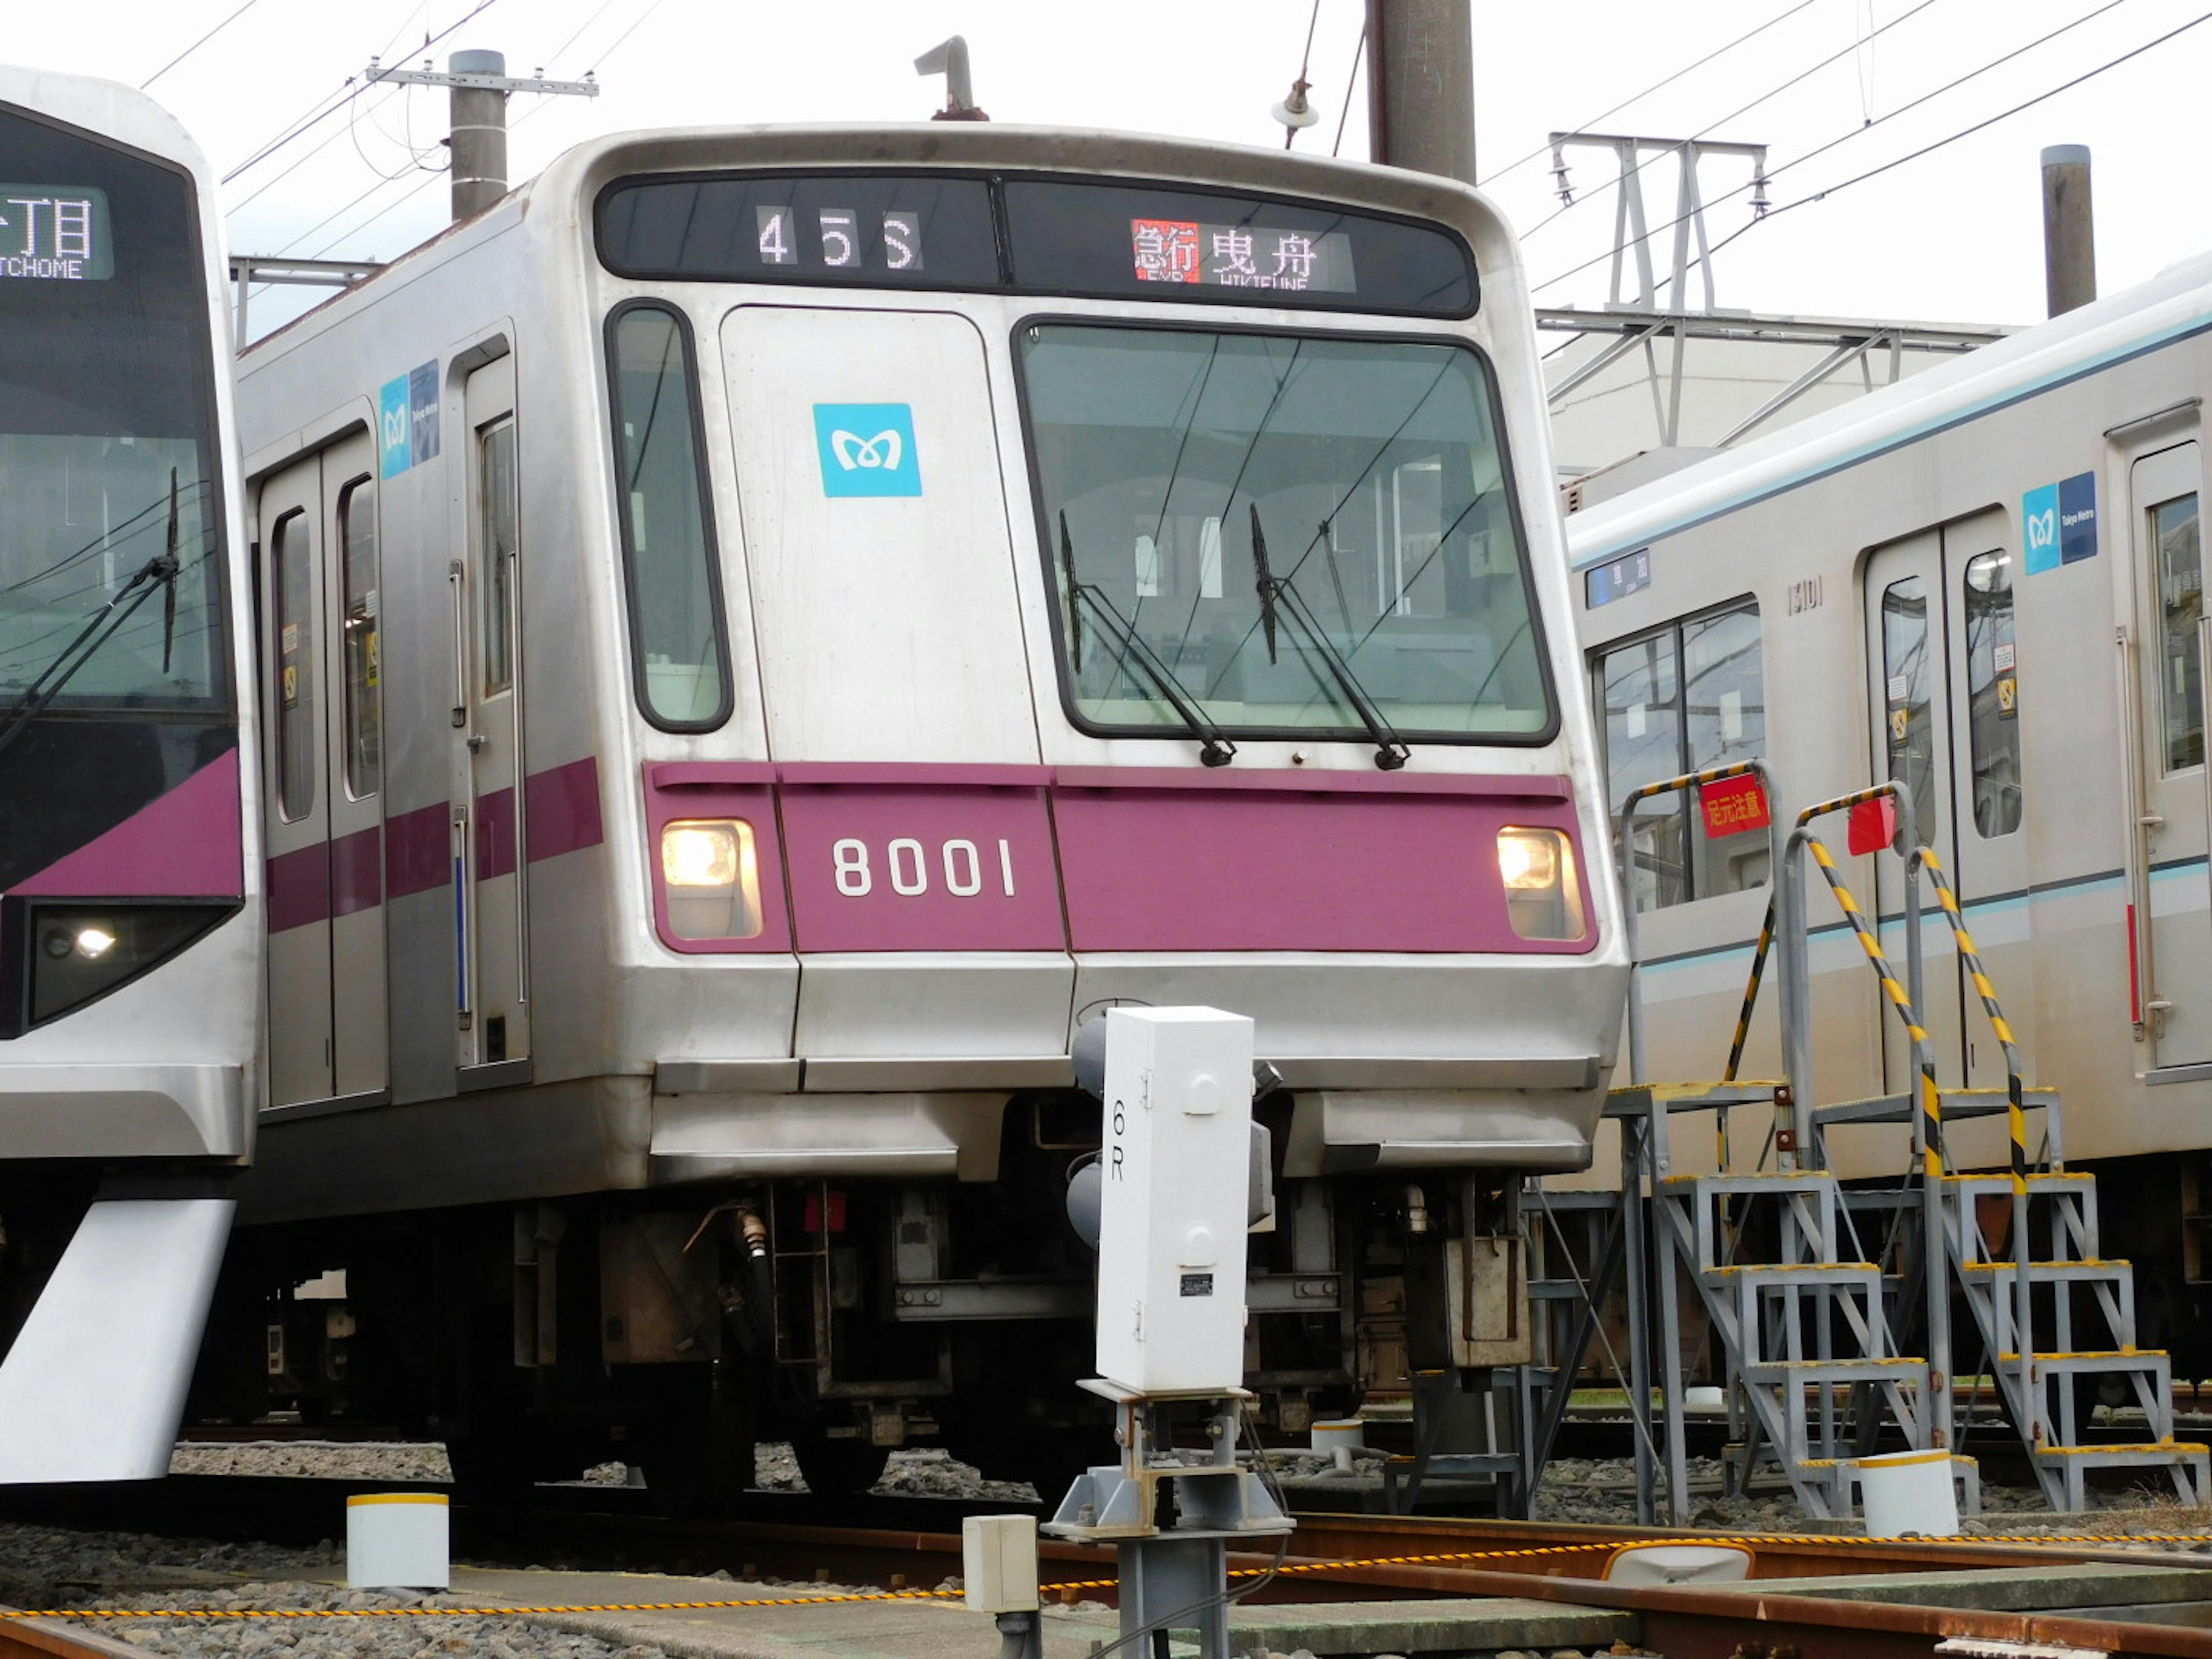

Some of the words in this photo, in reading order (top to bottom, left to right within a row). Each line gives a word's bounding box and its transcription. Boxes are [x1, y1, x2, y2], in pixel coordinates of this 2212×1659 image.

[1134, 222, 1196, 271] 急行
[2061, 514, 2078, 527] Tokyo
[2078, 509, 2094, 522] Metro
[1707, 790, 1761, 827] 足元注意
[833, 838, 1015, 897] 8001
